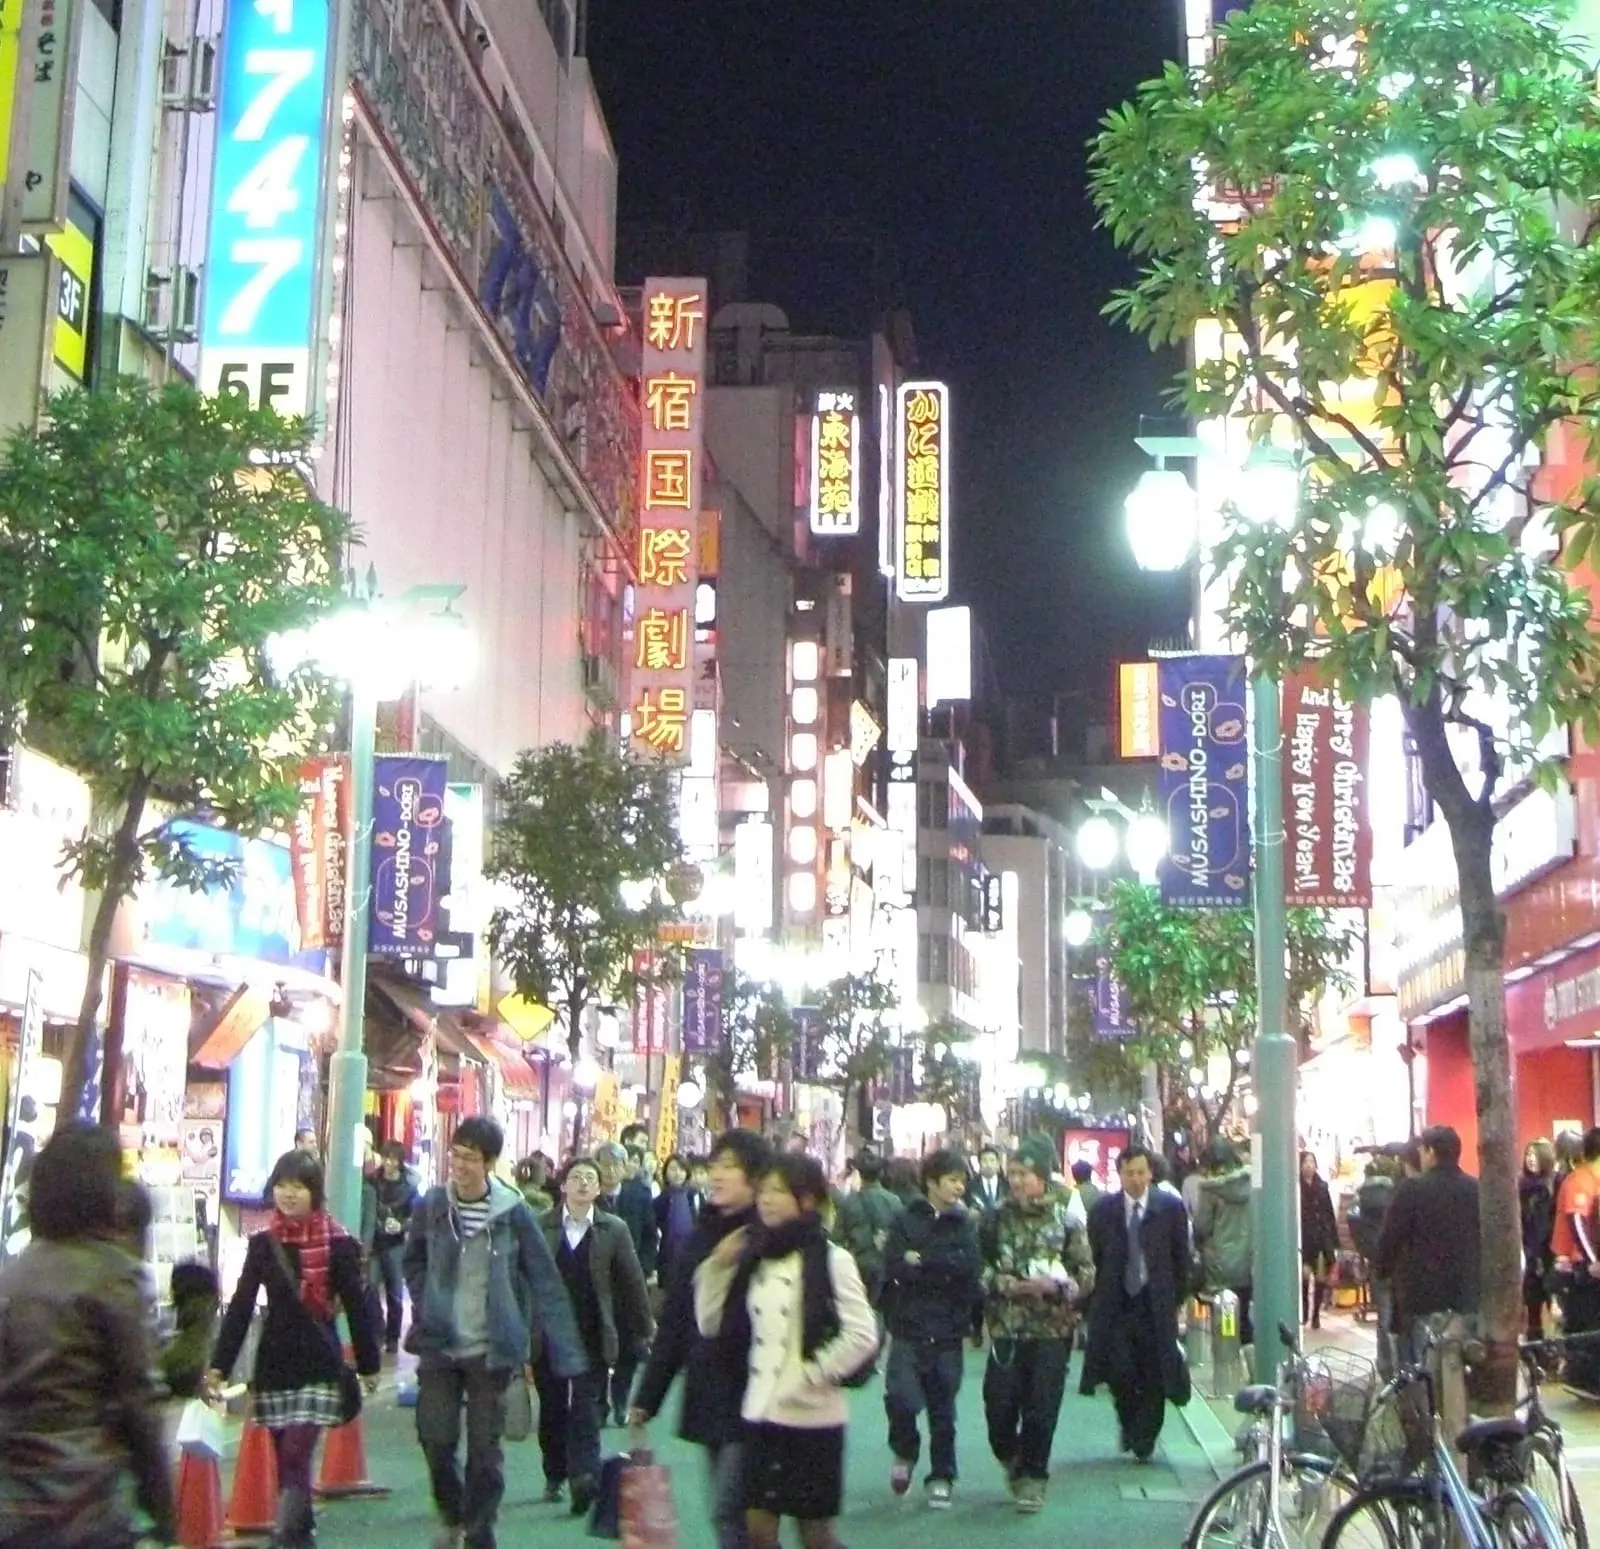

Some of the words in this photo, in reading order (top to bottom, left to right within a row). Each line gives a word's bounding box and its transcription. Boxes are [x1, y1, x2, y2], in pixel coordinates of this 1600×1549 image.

[60, 270, 81, 322] 3F
[635, 292, 703, 752] 新宿国際劇場
[1187, 691, 1209, 888] MUSASHINO-DORI
[1291, 712, 1321, 777] Happy
[392, 783, 414, 938] MUSASHINO-DORI
